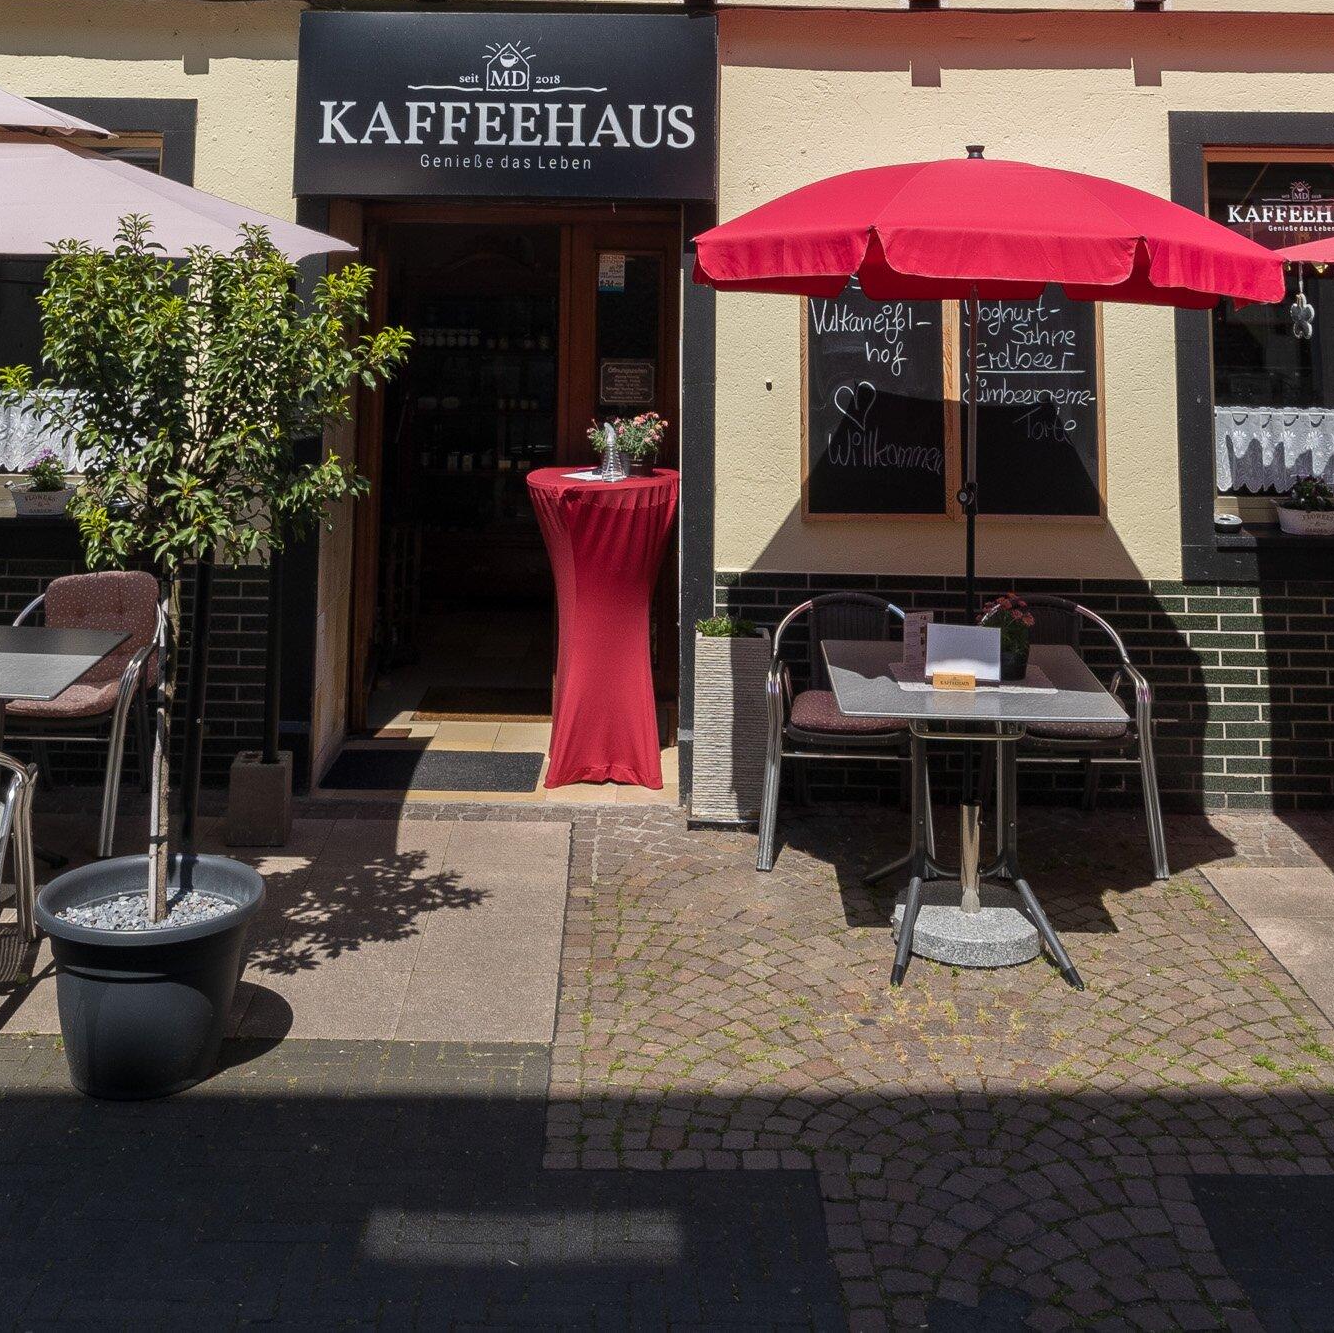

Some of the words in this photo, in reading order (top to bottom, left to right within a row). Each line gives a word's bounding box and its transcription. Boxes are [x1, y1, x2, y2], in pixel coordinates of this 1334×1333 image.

[459, 73, 480, 84] seit
[490, 70, 526, 87] MD
[535, 74, 560, 84] 2018
[318, 100, 695, 149] KAFFEEHAUS
[420, 153, 494, 169] Genieße
[500, 154, 531, 169] das
[538, 155, 591, 170] Leben
[1010, 322, 1076, 347] Sahne
[865, 341, 907, 377] hof
